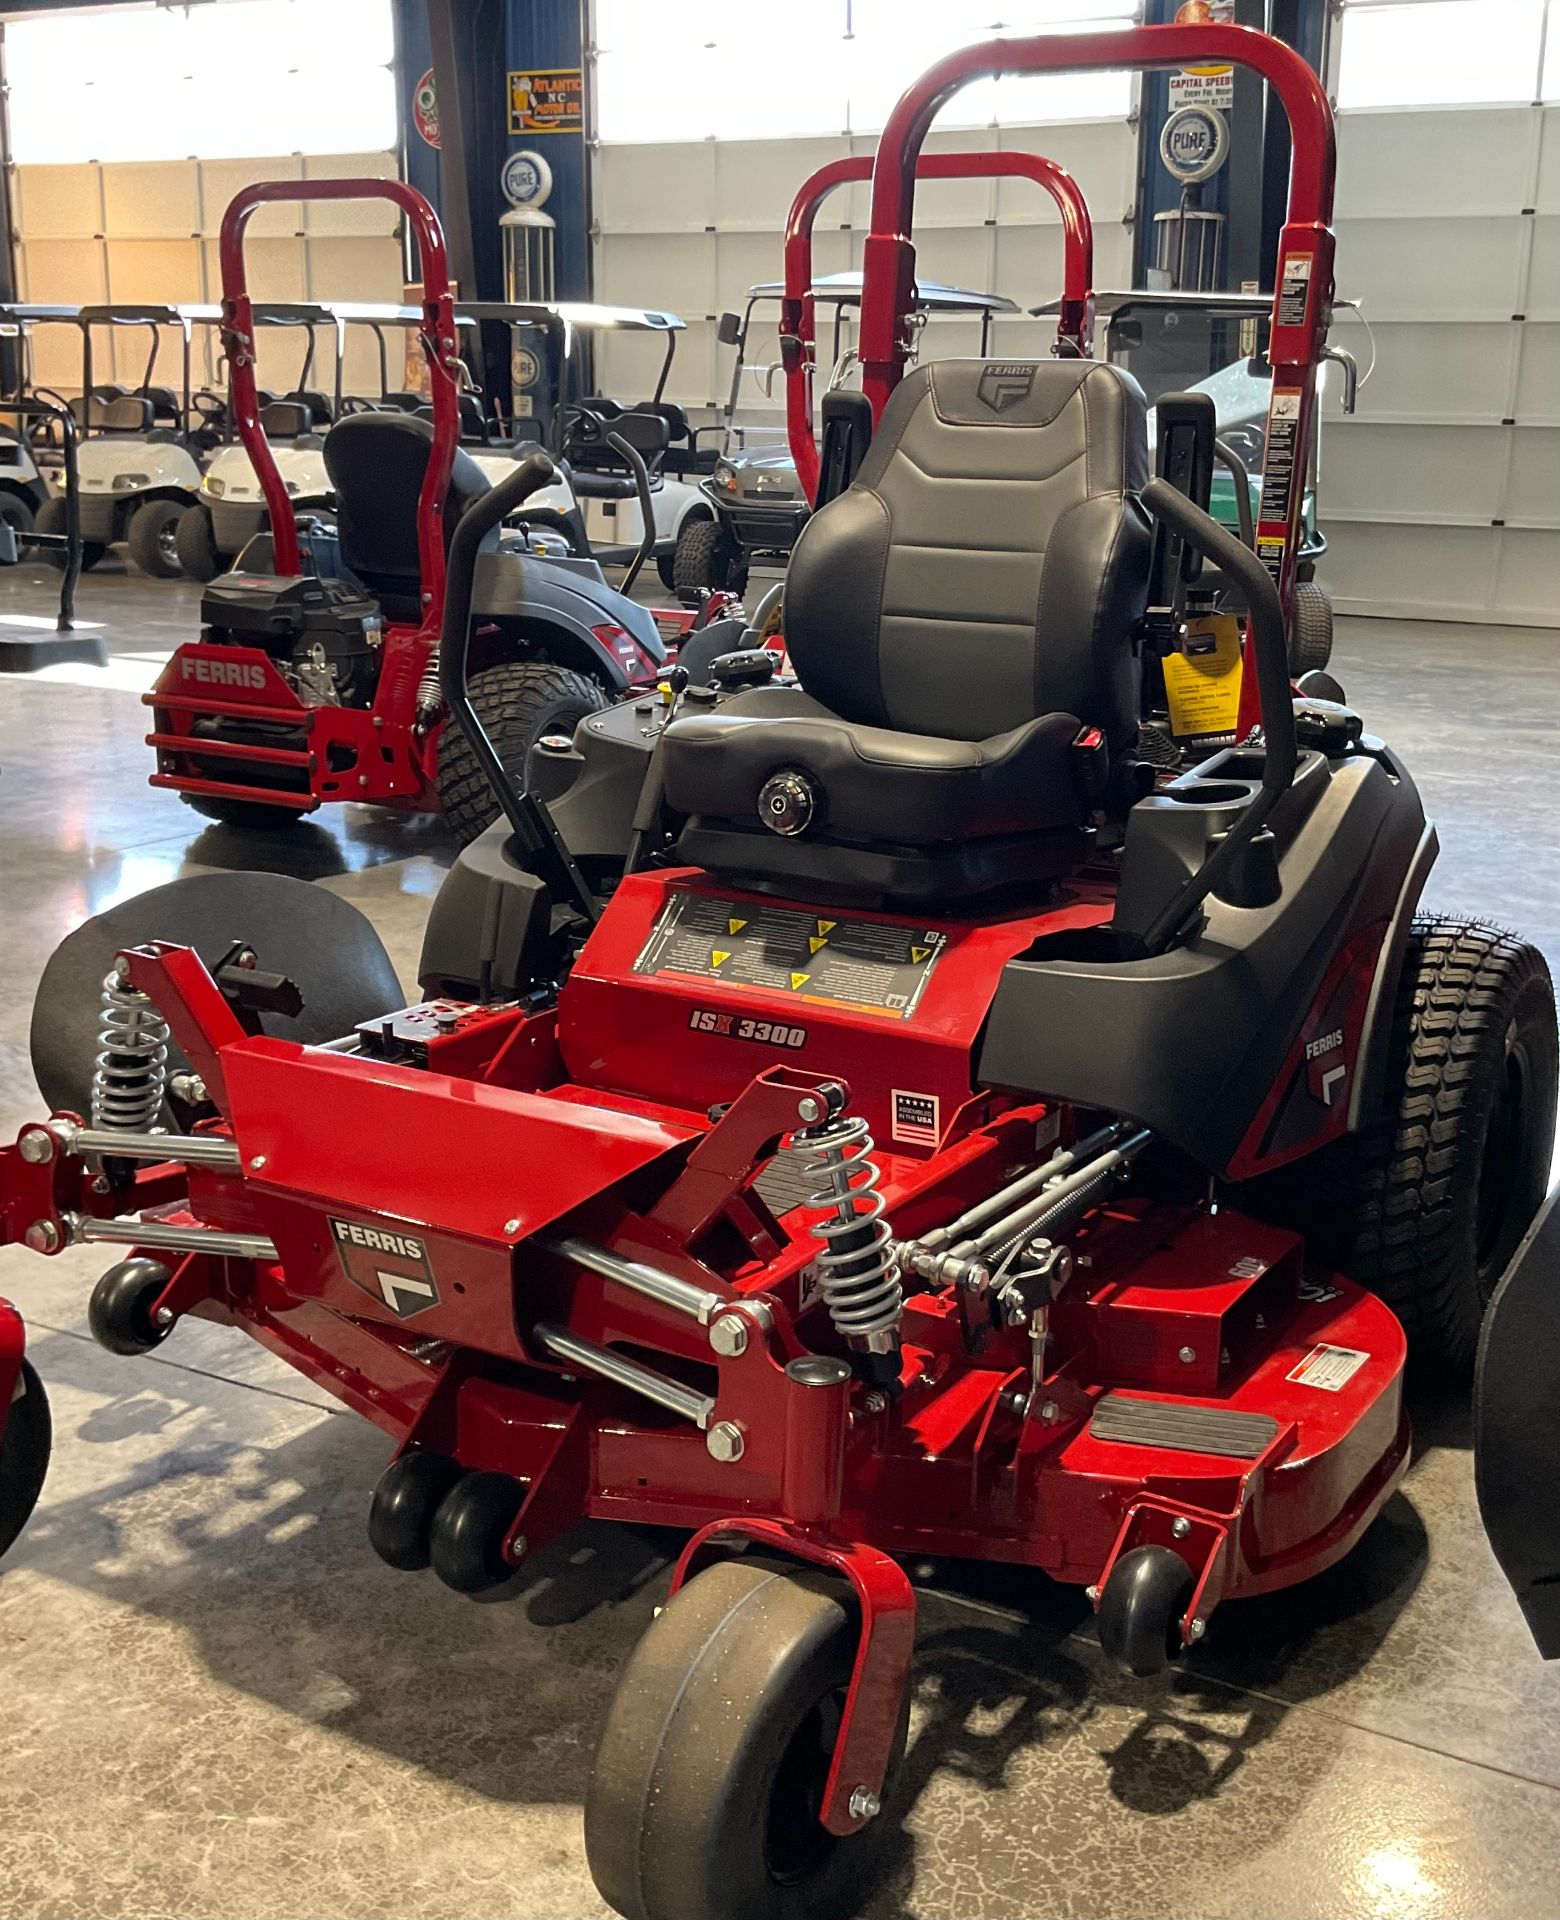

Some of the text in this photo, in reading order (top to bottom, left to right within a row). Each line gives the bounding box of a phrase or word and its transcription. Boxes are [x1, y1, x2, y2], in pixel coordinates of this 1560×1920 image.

[1171, 76, 1233, 88] CAPITAL SPEED
[535, 103, 565, 115] MOTOR
[1173, 132, 1207, 150] PURE
[509, 172, 534, 187] PURE
[987, 366, 1034, 375] FERRIS
[181, 657, 266, 689] FERRIS
[690, 1010, 806, 1047] ISX 3300
[1305, 1028, 1344, 1060] FERRIS
[898, 1106, 932, 1118] ASSEMBLED
[917, 1116, 932, 1125] USA
[334, 1221, 422, 1259] FERRIS
